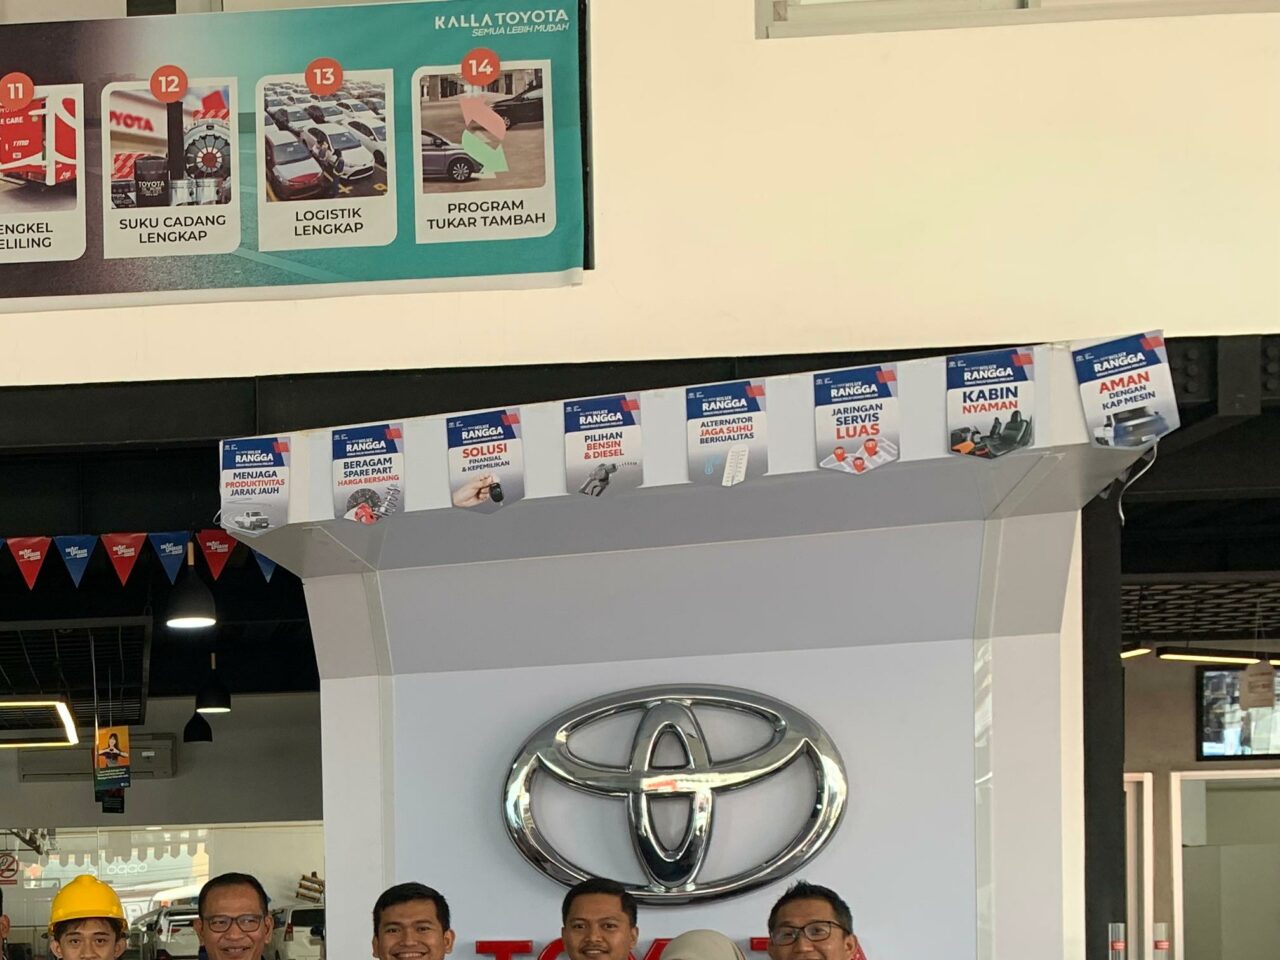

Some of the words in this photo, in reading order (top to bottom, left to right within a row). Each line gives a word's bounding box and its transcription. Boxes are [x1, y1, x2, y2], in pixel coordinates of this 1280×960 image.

[435, 14, 492, 29] KALLA
[495, 9, 569, 25] TOYOTA
[472, 26, 505, 37] SEMUA
[507, 25, 533, 35] LEBIH
[534, 23, 569, 33] MUDAH
[468, 59, 494, 76] 14
[313, 68, 335, 85] 13
[7, 83, 23, 99] 11
[158, 75, 180, 93] 12
[110, 110, 154, 132] YOTA
[294, 206, 362, 222] LOGISTIK
[447, 200, 524, 215] PROGRAM
[119, 216, 160, 231] SUKU
[163, 214, 226, 230] CADANG
[426, 215, 476, 231] TUKAR
[479, 212, 546, 228] TAMBAH
[293, 221, 364, 238] LENGKAP
[138, 229, 208, 245] LENGKAP
[1093, 352, 1146, 373] RANGGA
[964, 367, 1014, 380] RANGGA
[1099, 371, 1151, 394] AMAN
[830, 384, 878, 398] RANGGA
[963, 386, 1018, 403] KABIN
[1108, 385, 1147, 400] DENGAN
[702, 399, 747, 411] RANGGA
[962, 400, 1018, 414] NYAMAN
[1102, 400, 1125, 411] KAP
[1125, 391, 1156, 405] MESIN
[831, 403, 883, 417] JARINGAN
[579, 413, 623, 425] RANGGA
[700, 416, 753, 428] ALTERNATOR
[835, 413, 880, 426] SERVIS
[462, 427, 504, 439] RANGGA
[584, 431, 623, 443] PILIHAN
[700, 428, 725, 437] JAGA
[726, 424, 753, 434] SUHU
[836, 423, 880, 440] LUAS
[586, 441, 621, 450] BENSIN
[700, 432, 754, 445] BERKUALITAS
[346, 441, 386, 452] RANGGA
[463, 443, 507, 459] SOLUSI
[235, 453, 274, 463] RANGGA
[469, 455, 502, 465] FINANSIAL
[593, 449, 625, 459] DIESEL
[343, 457, 392, 470] BERAGAM
[468, 460, 510, 472] KEPEMILIKAN
[233, 470, 278, 480] MENJAGA
[343, 468, 370, 478] SPARE
[371, 467, 392, 476] PART
[225, 479, 285, 488] PRODUKTIVITAS
[337, 477, 363, 486] HARGA
[363, 475, 400, 485] BERSAING
[230, 488, 257, 497] JARAK
[258, 487, 280, 495] JAUH
